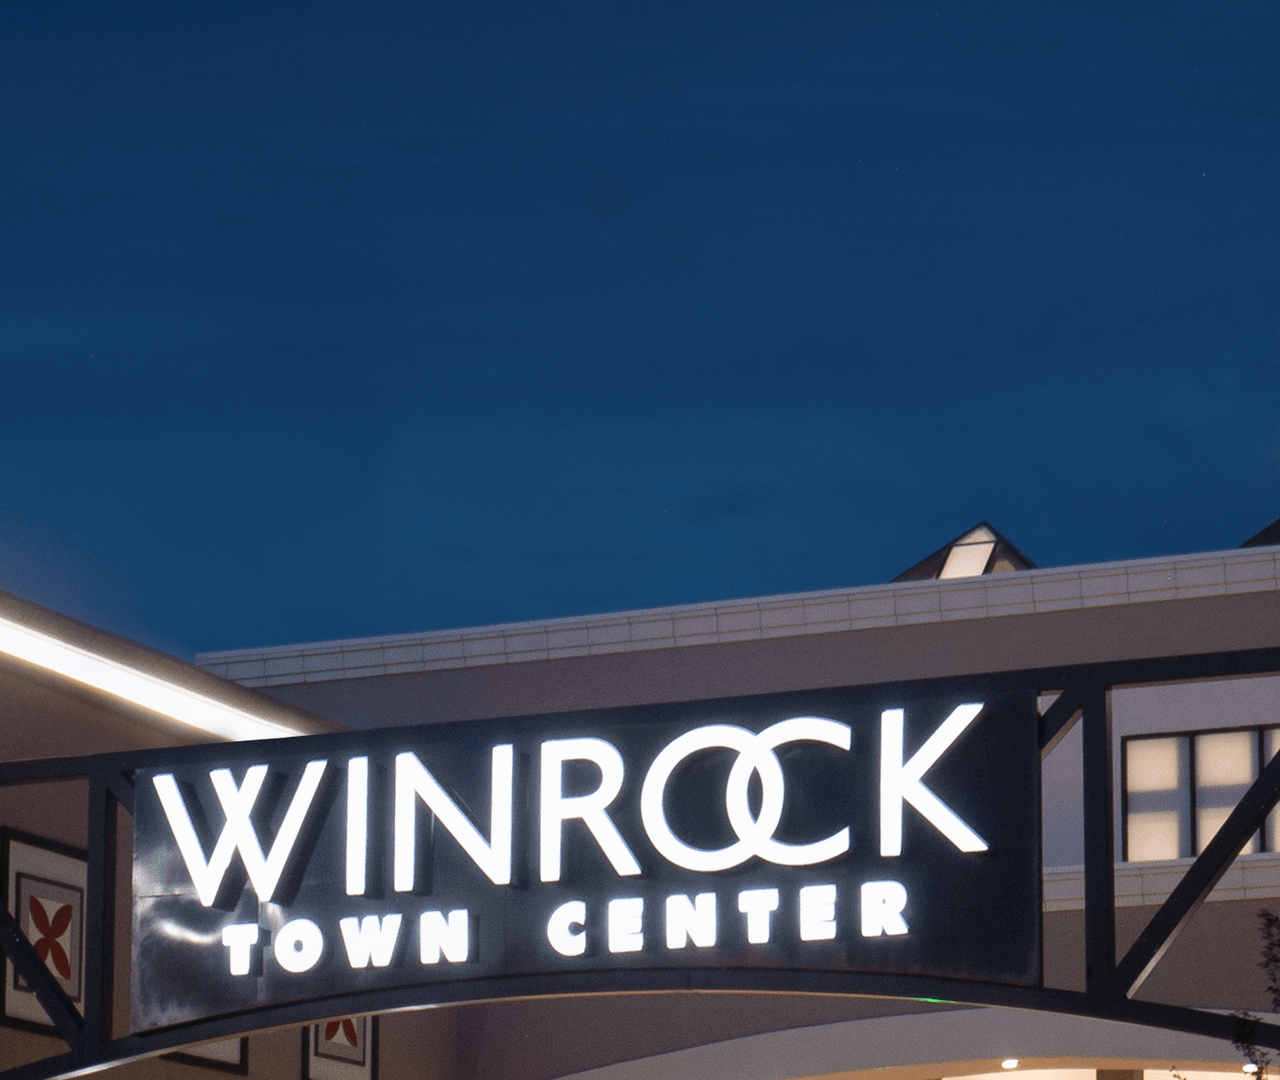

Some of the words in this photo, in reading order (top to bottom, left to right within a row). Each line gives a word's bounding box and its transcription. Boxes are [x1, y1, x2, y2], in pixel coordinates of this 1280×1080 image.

[151, 702, 990, 908] WINROCK
[222, 909, 471, 977] TOWN
[546, 880, 911, 957] CENTER
